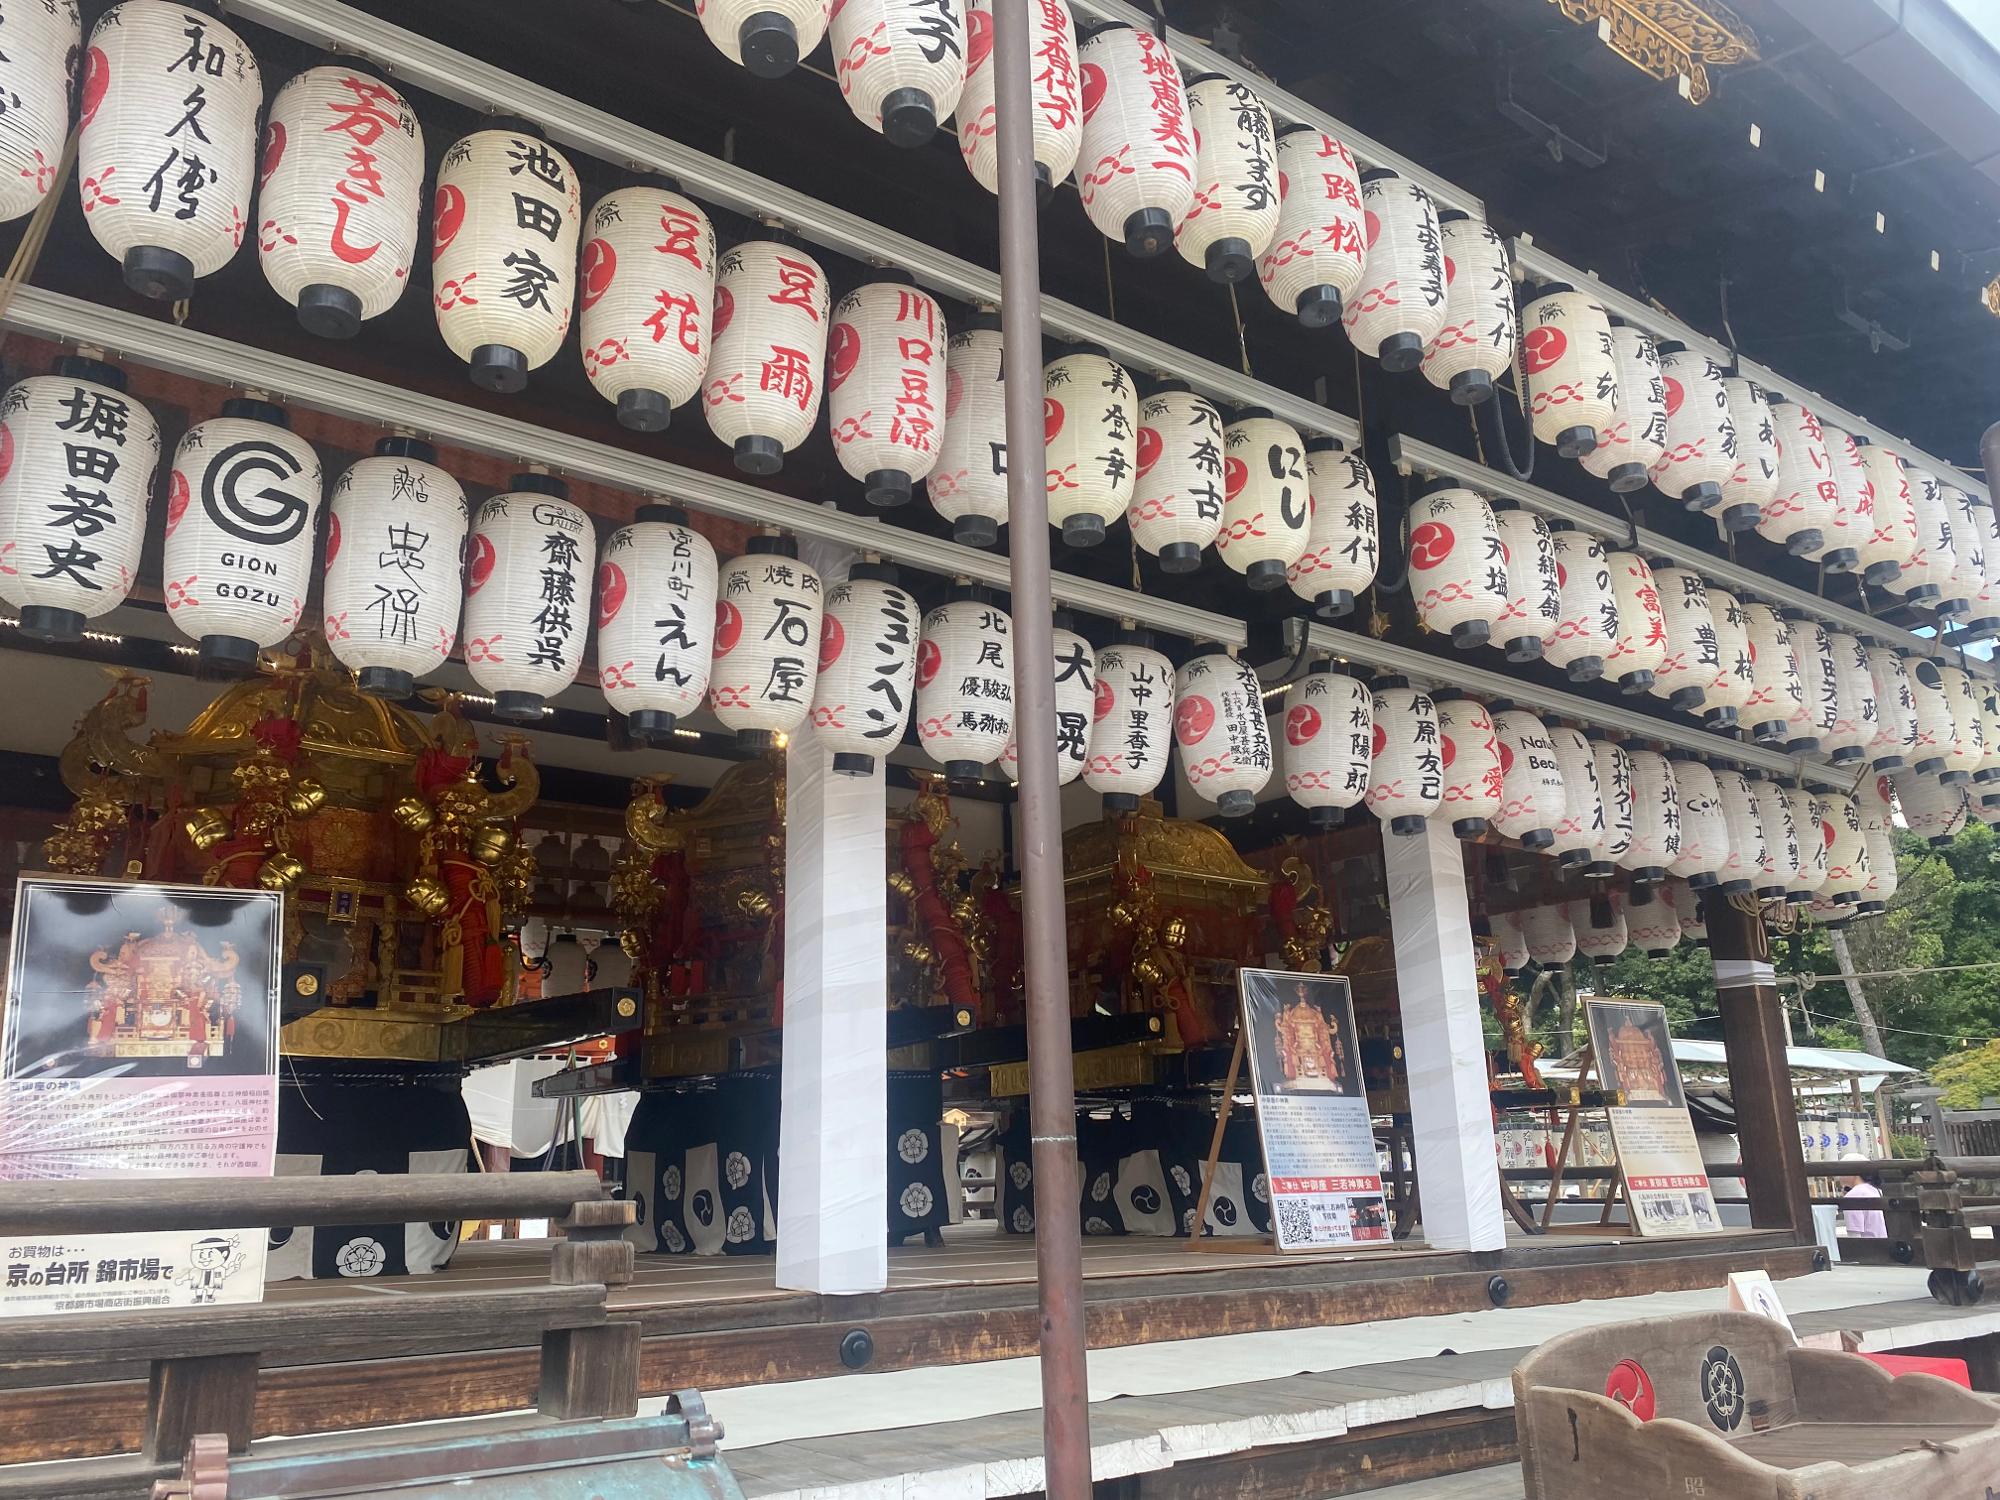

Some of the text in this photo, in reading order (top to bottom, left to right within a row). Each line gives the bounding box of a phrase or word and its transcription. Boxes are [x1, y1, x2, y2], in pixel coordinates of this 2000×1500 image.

[324, 75, 402, 264] 芳きし
[500, 139, 567, 315] 池田家
[642, 204, 703, 355] 豆花
[1095, 362, 1134, 489] 美登幸
[1189, 400, 1225, 520] 元奈古
[31, 387, 130, 591] 堀田芳史
[1268, 443, 1306, 529] にし
[216, 583, 280, 607] GOZU
[221, 552, 278, 576] GION
[654, 528, 697, 687] 宮川町 えん
[763, 565, 820, 595] 焼肉
[760, 597, 812, 704] 石屋
[862, 589, 911, 738] ミュンヘン
[978, 611, 1008, 668] 北尾
[1055, 643, 1095, 761] 大晃
[1125, 662, 1155, 770] 山中里香子
[1343, 682, 1372, 798] 小松陽一郎
[1409, 695, 1443, 800] 伊原友己
[6, 1257, 174, 1288] 京の台所 錦市場で
